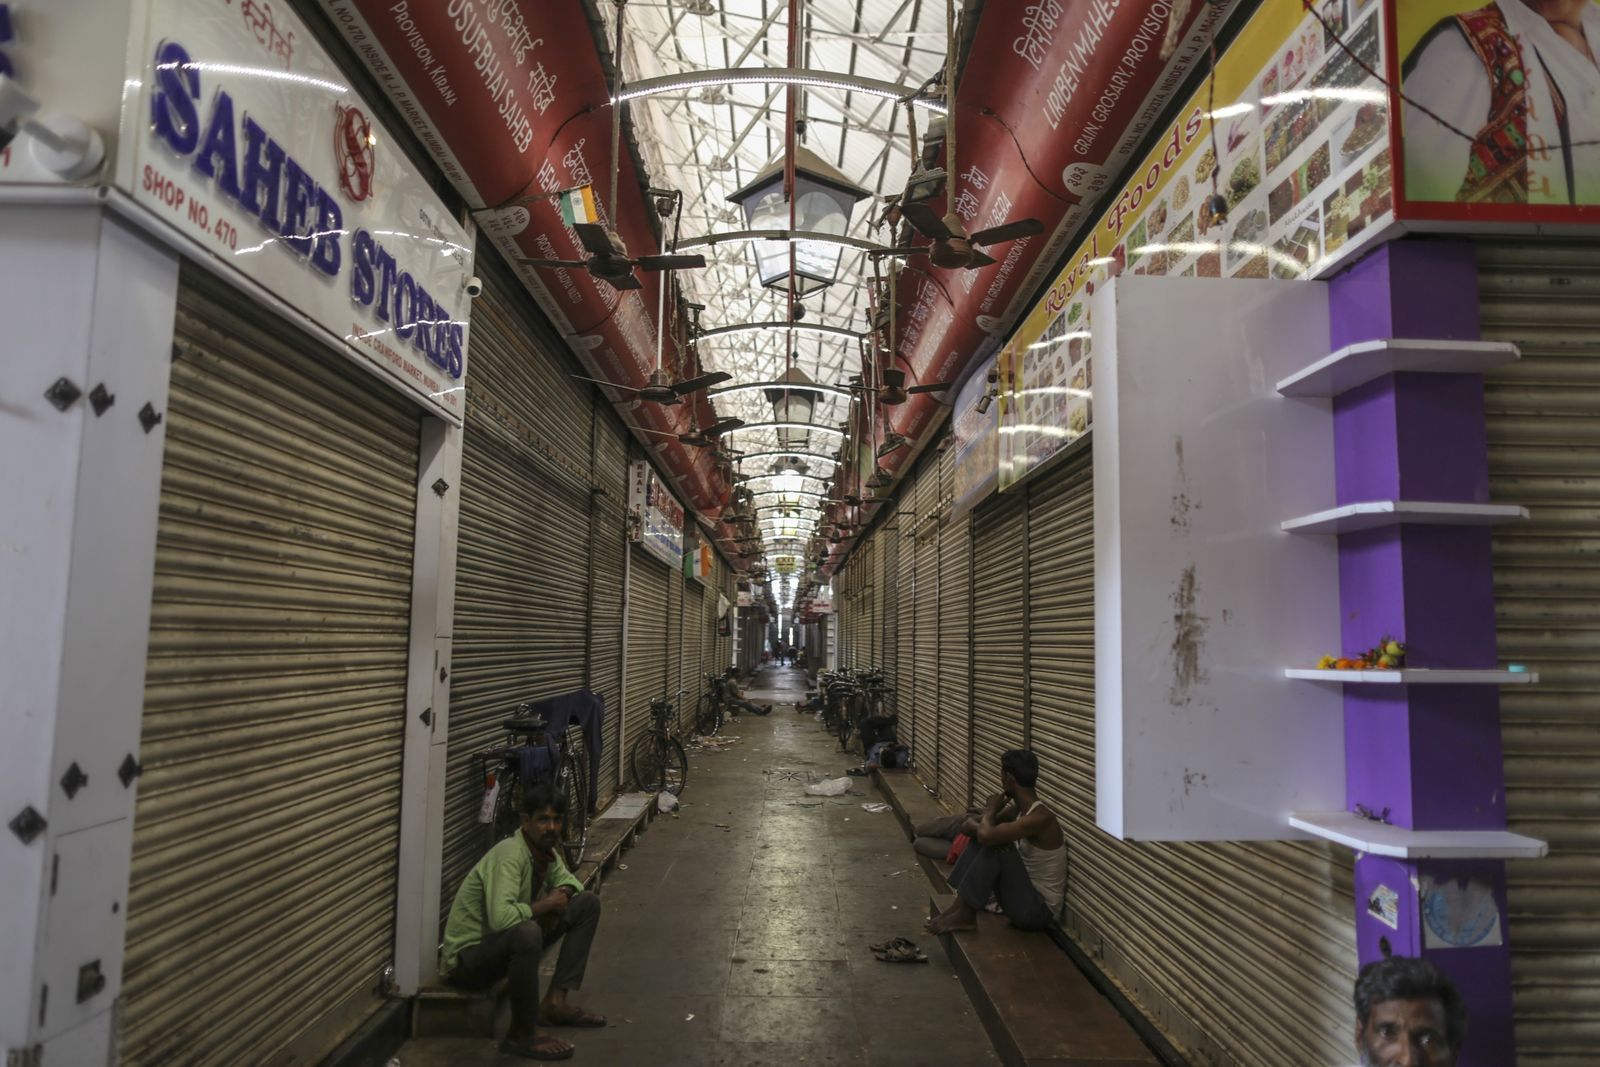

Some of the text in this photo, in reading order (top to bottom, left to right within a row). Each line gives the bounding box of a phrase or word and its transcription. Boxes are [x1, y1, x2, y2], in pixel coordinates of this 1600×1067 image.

[360, 43, 388, 73] INSIDE
[390, 1, 459, 107] PROVISION, KIRANA
[527, 62, 557, 116] साहेब
[1160, 65, 1186, 93] INSIDE
[499, 89, 533, 153] SAHEB
[1043, 50, 1084, 131] LIRIBEN
[1073, 121, 1104, 155] GRAIN,
[1092, 66, 1136, 122] GROSARY,
[143, 165, 238, 250] SHOP NO. 470
[152, 40, 342, 276] SAHEB
[353, 229, 463, 379] STORES
[1044, 234, 1099, 317] Royal
[1107, 108, 1202, 237] Foods
[373, 338, 402, 368] CRAWFORD
[635, 463, 643, 494] REAL
